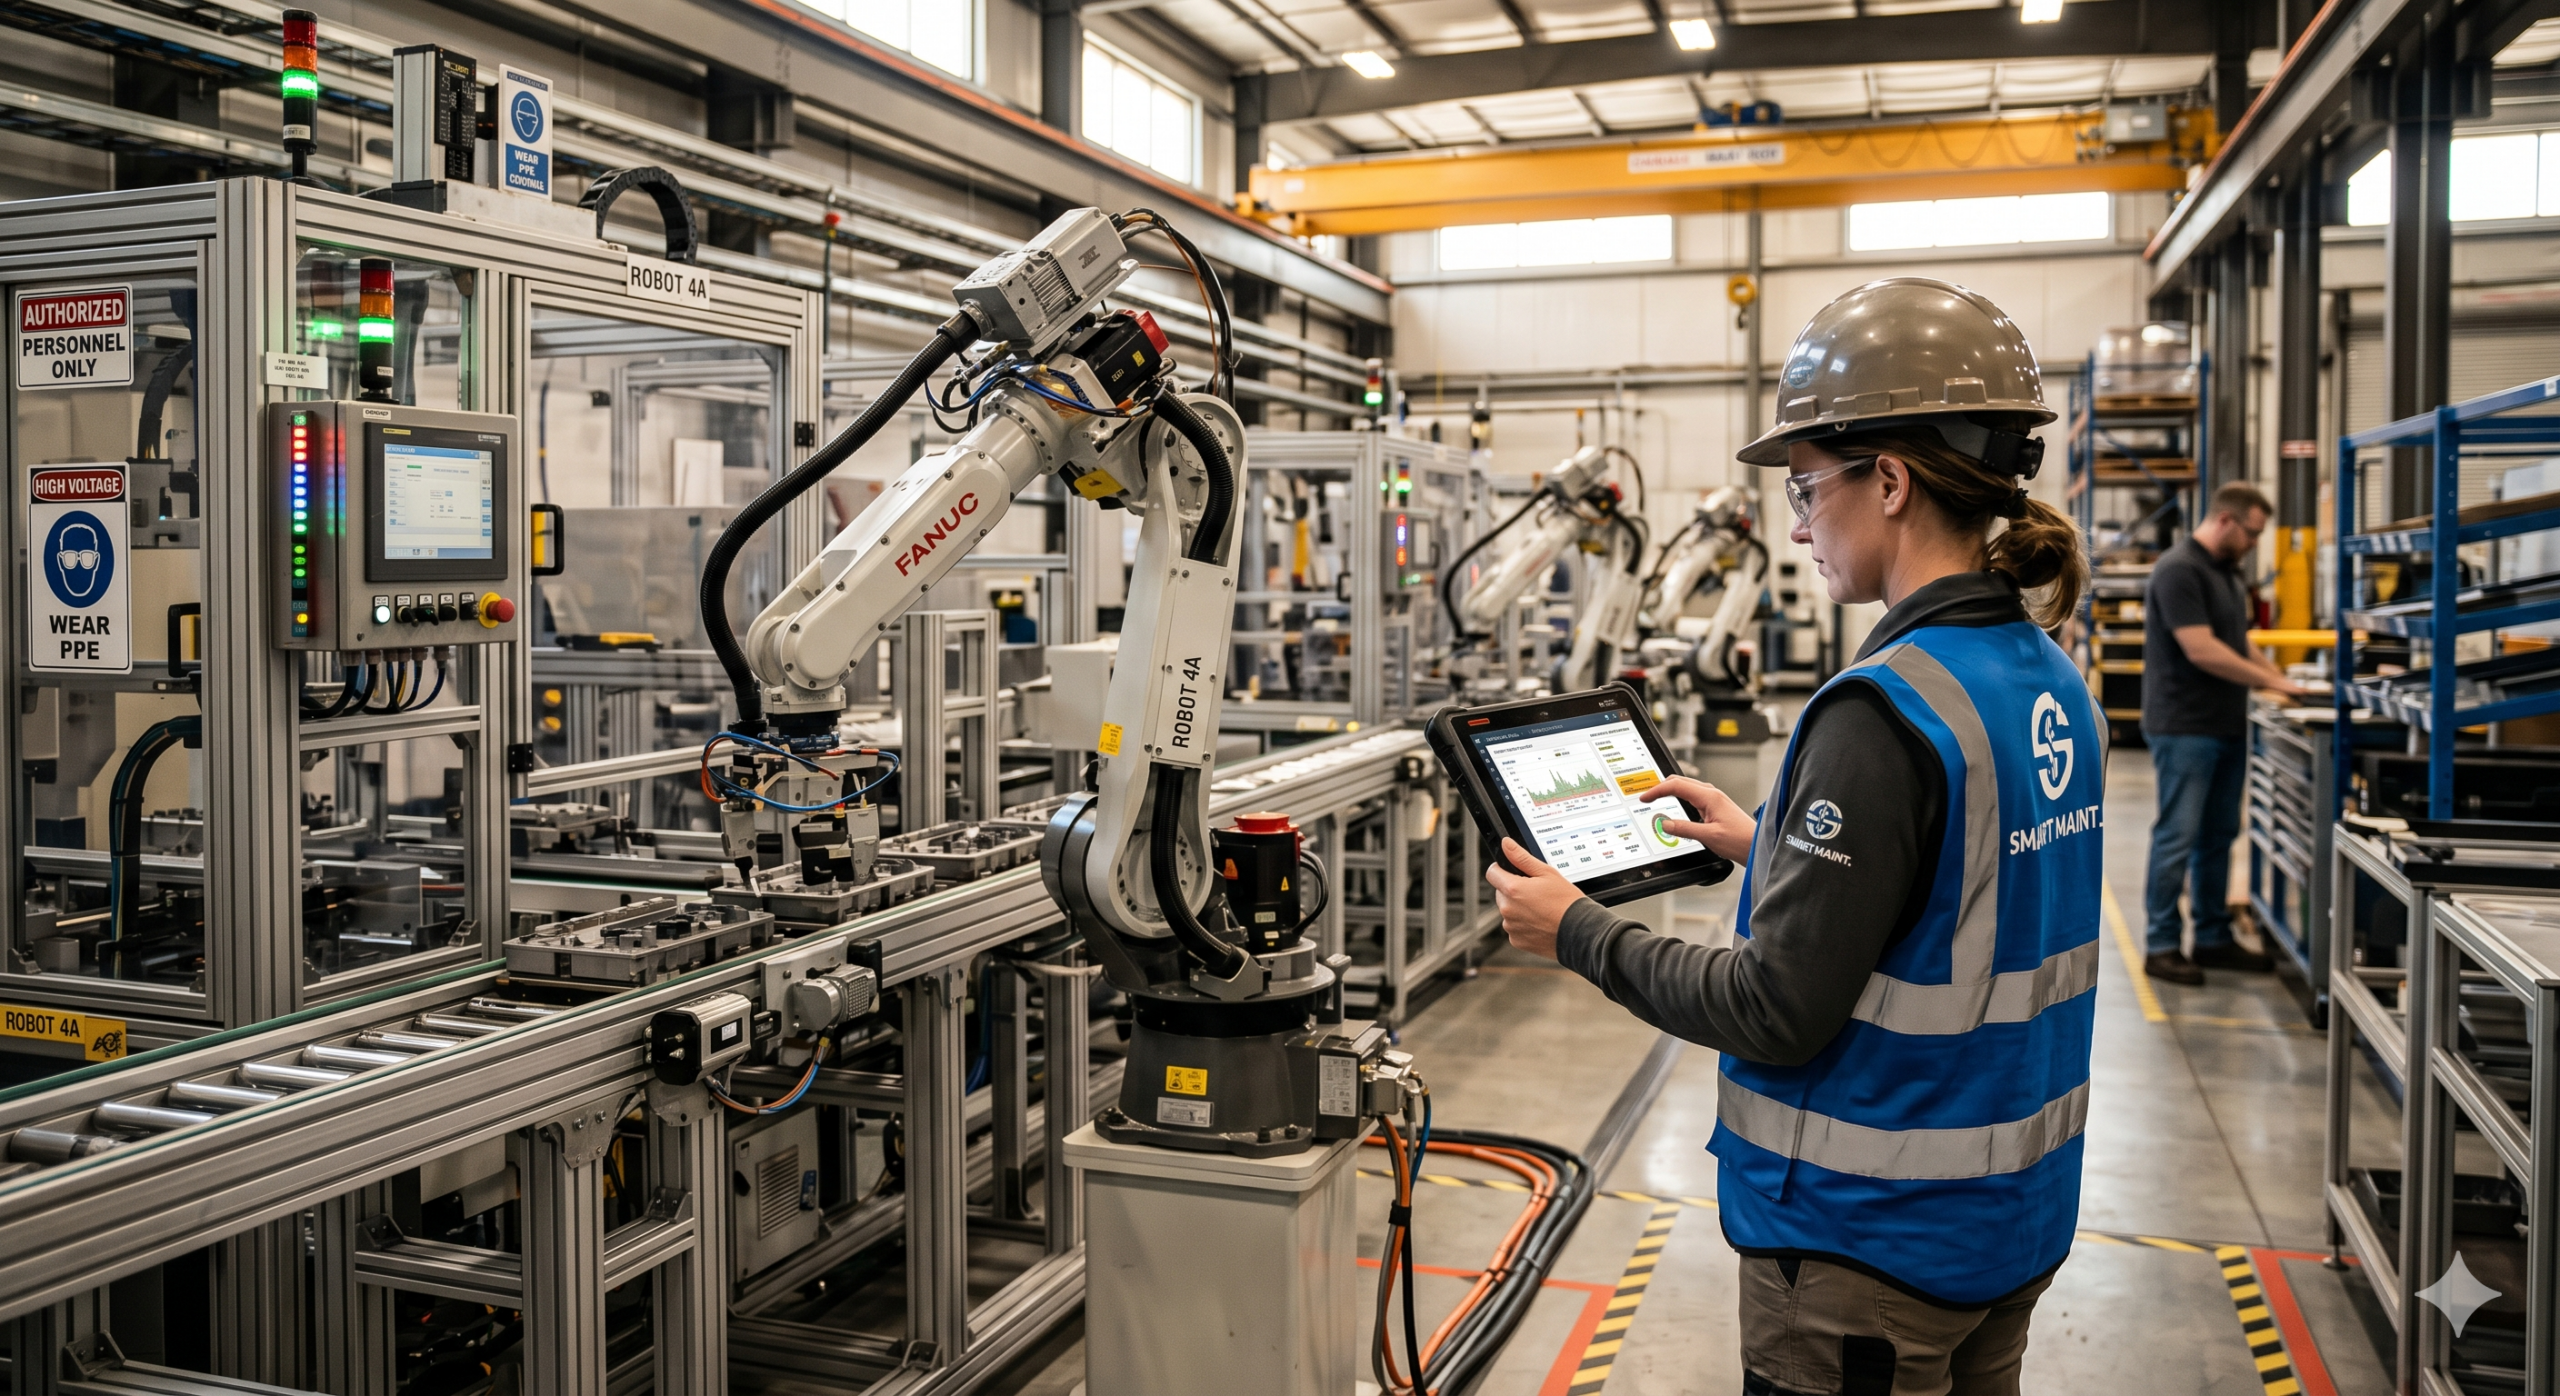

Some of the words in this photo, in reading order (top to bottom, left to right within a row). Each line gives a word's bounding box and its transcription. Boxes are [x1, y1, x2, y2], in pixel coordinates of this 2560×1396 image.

[514, 150, 539, 165] WEAR
[518, 163, 536, 177] PPE
[631, 265, 683, 294] ROBOT
[688, 277, 707, 299] 4A
[24, 298, 124, 327] AUTHORIZED
[23, 332, 126, 357] PERSONNEL
[52, 358, 98, 379] ONLY
[35, 478, 66, 495] HIGH
[67, 477, 120, 494] VOLTAGE
[894, 492, 979, 577] FANUC
[49, 615, 110, 635] WEAR
[60, 640, 100, 660] PPE
[1182, 657, 1202, 681] 4A
[1171, 683, 1197, 748] ROBOT
[6, 1011, 55, 1035] ROBOT
[60, 1018, 80, 1038] 4A
